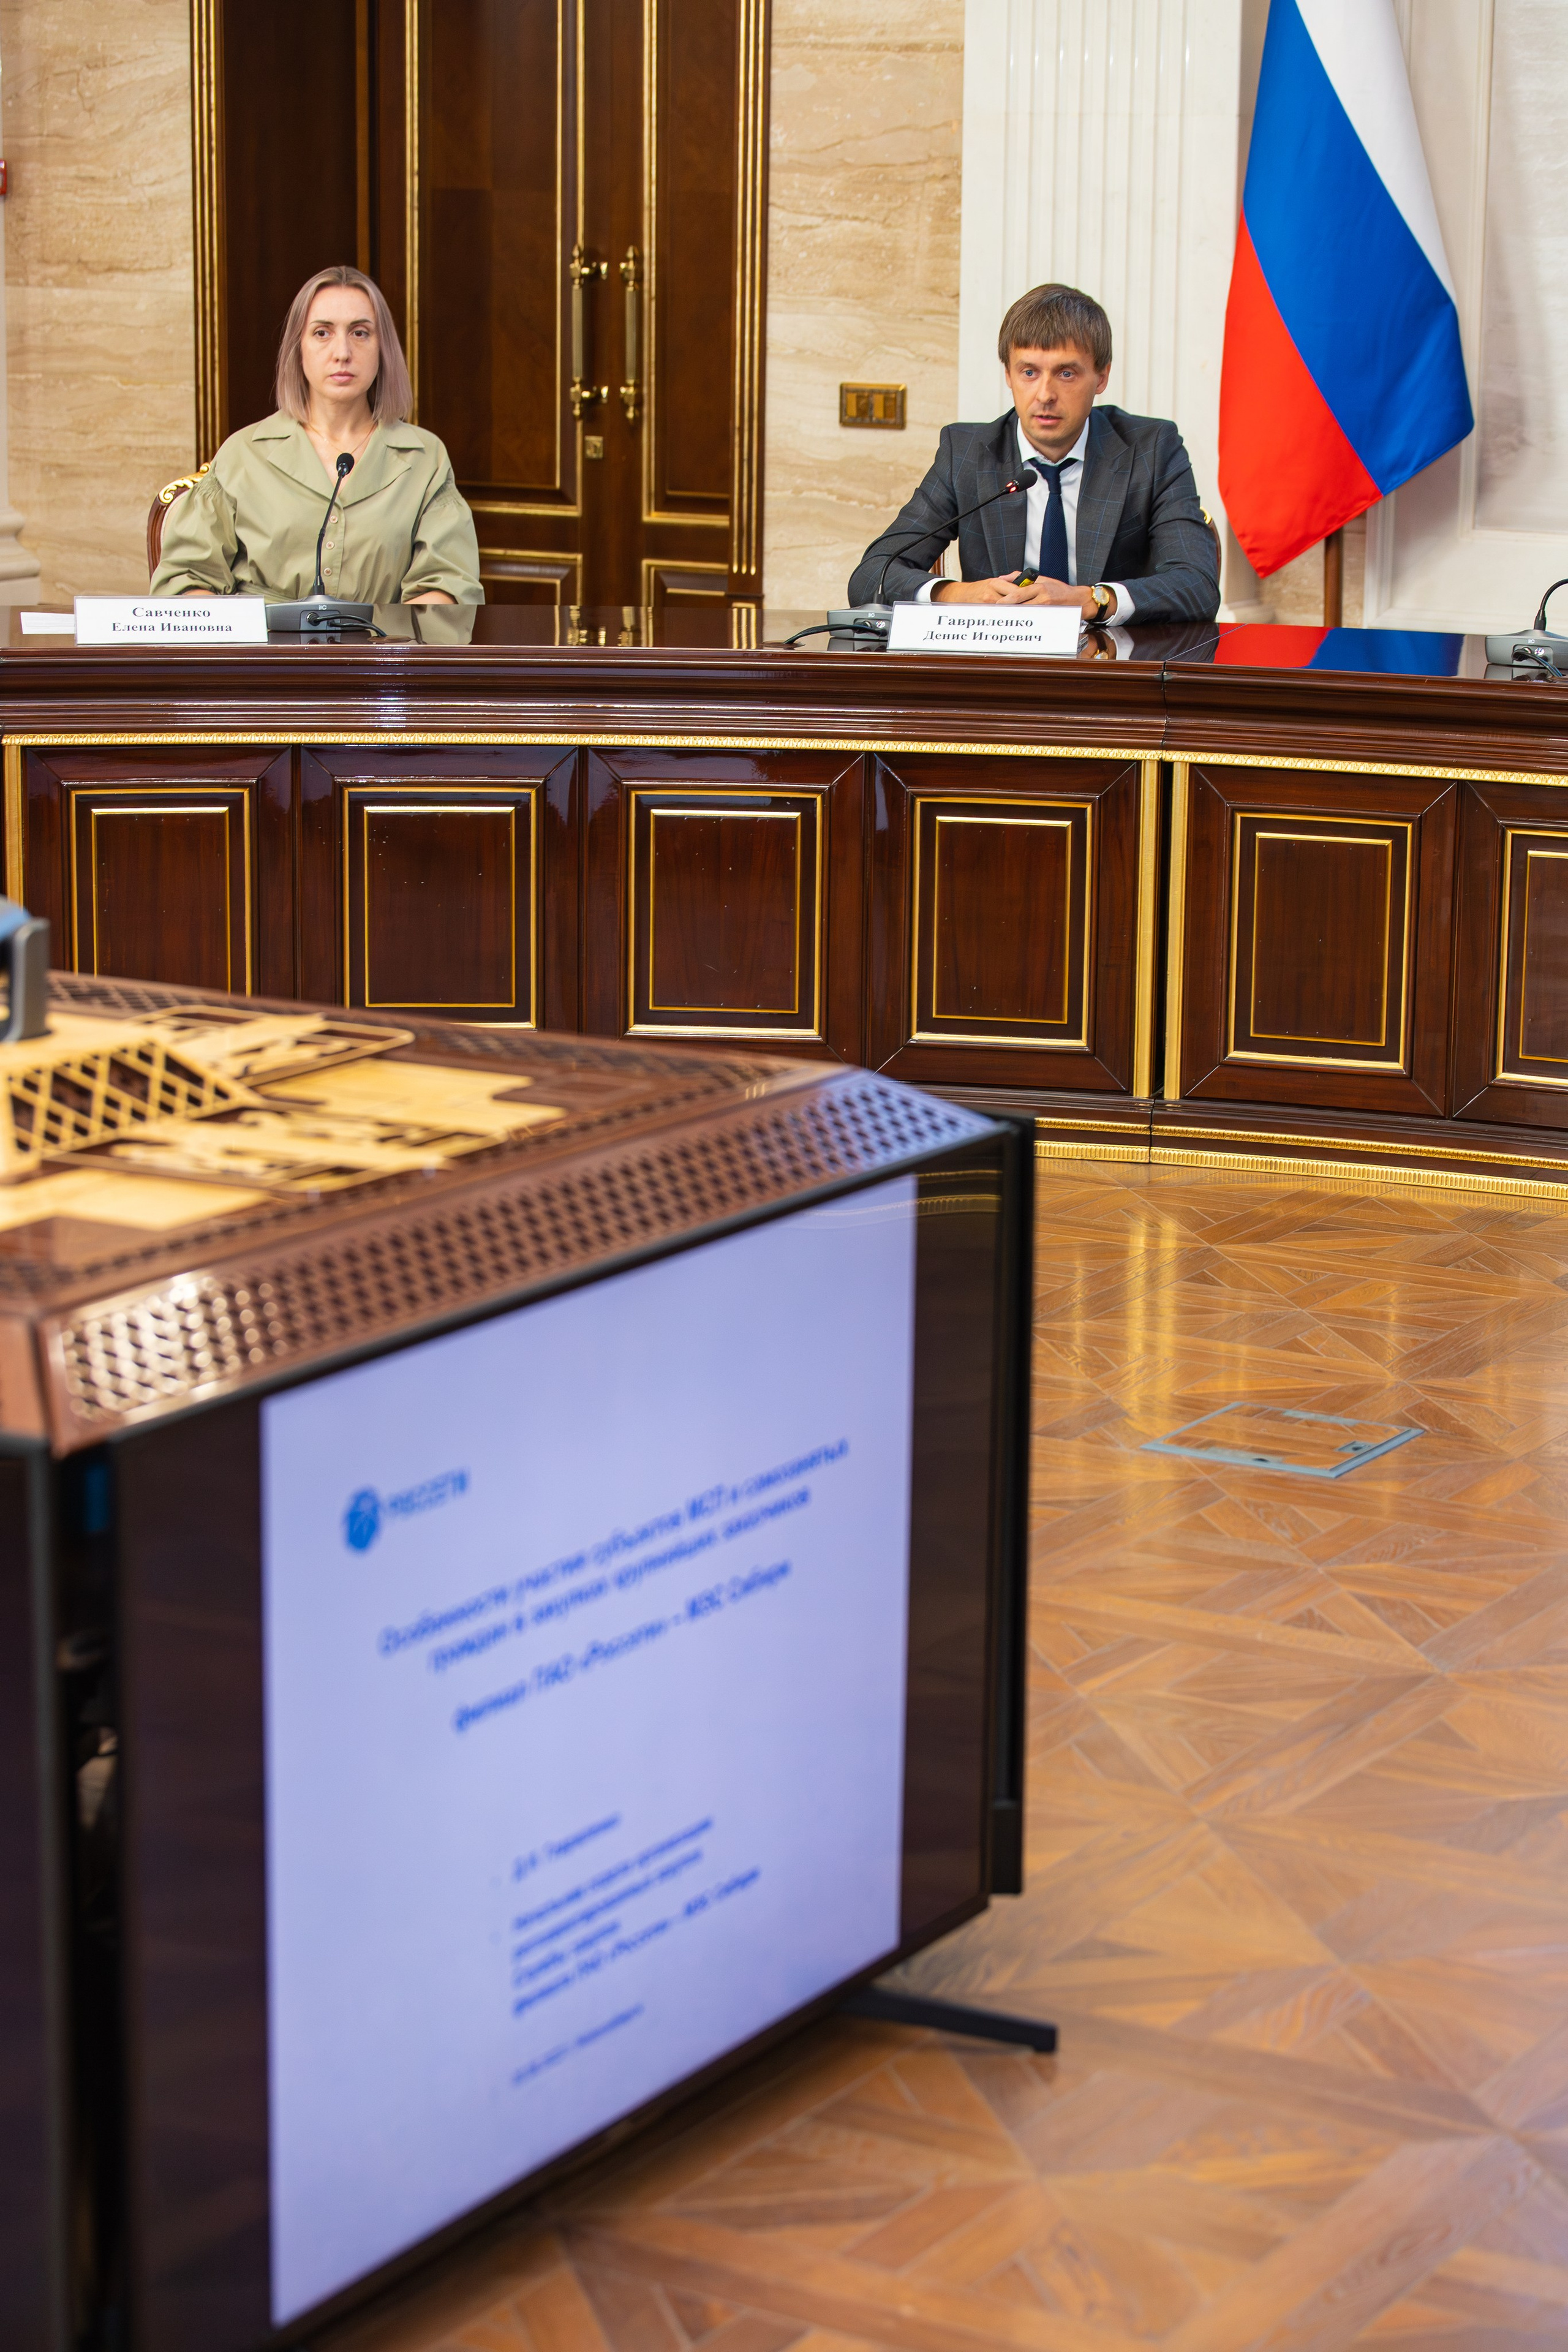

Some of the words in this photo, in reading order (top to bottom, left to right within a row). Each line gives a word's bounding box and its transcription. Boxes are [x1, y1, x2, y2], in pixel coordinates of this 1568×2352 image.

[132, 607, 211, 617] Савченко
[112, 622, 155, 632] Елена
[160, 622, 232, 632] Ивановна
[937, 615, 1033, 628] Гавриленко
[923, 630, 967, 641] Денис
[971, 631, 1042, 643] Игоревич
